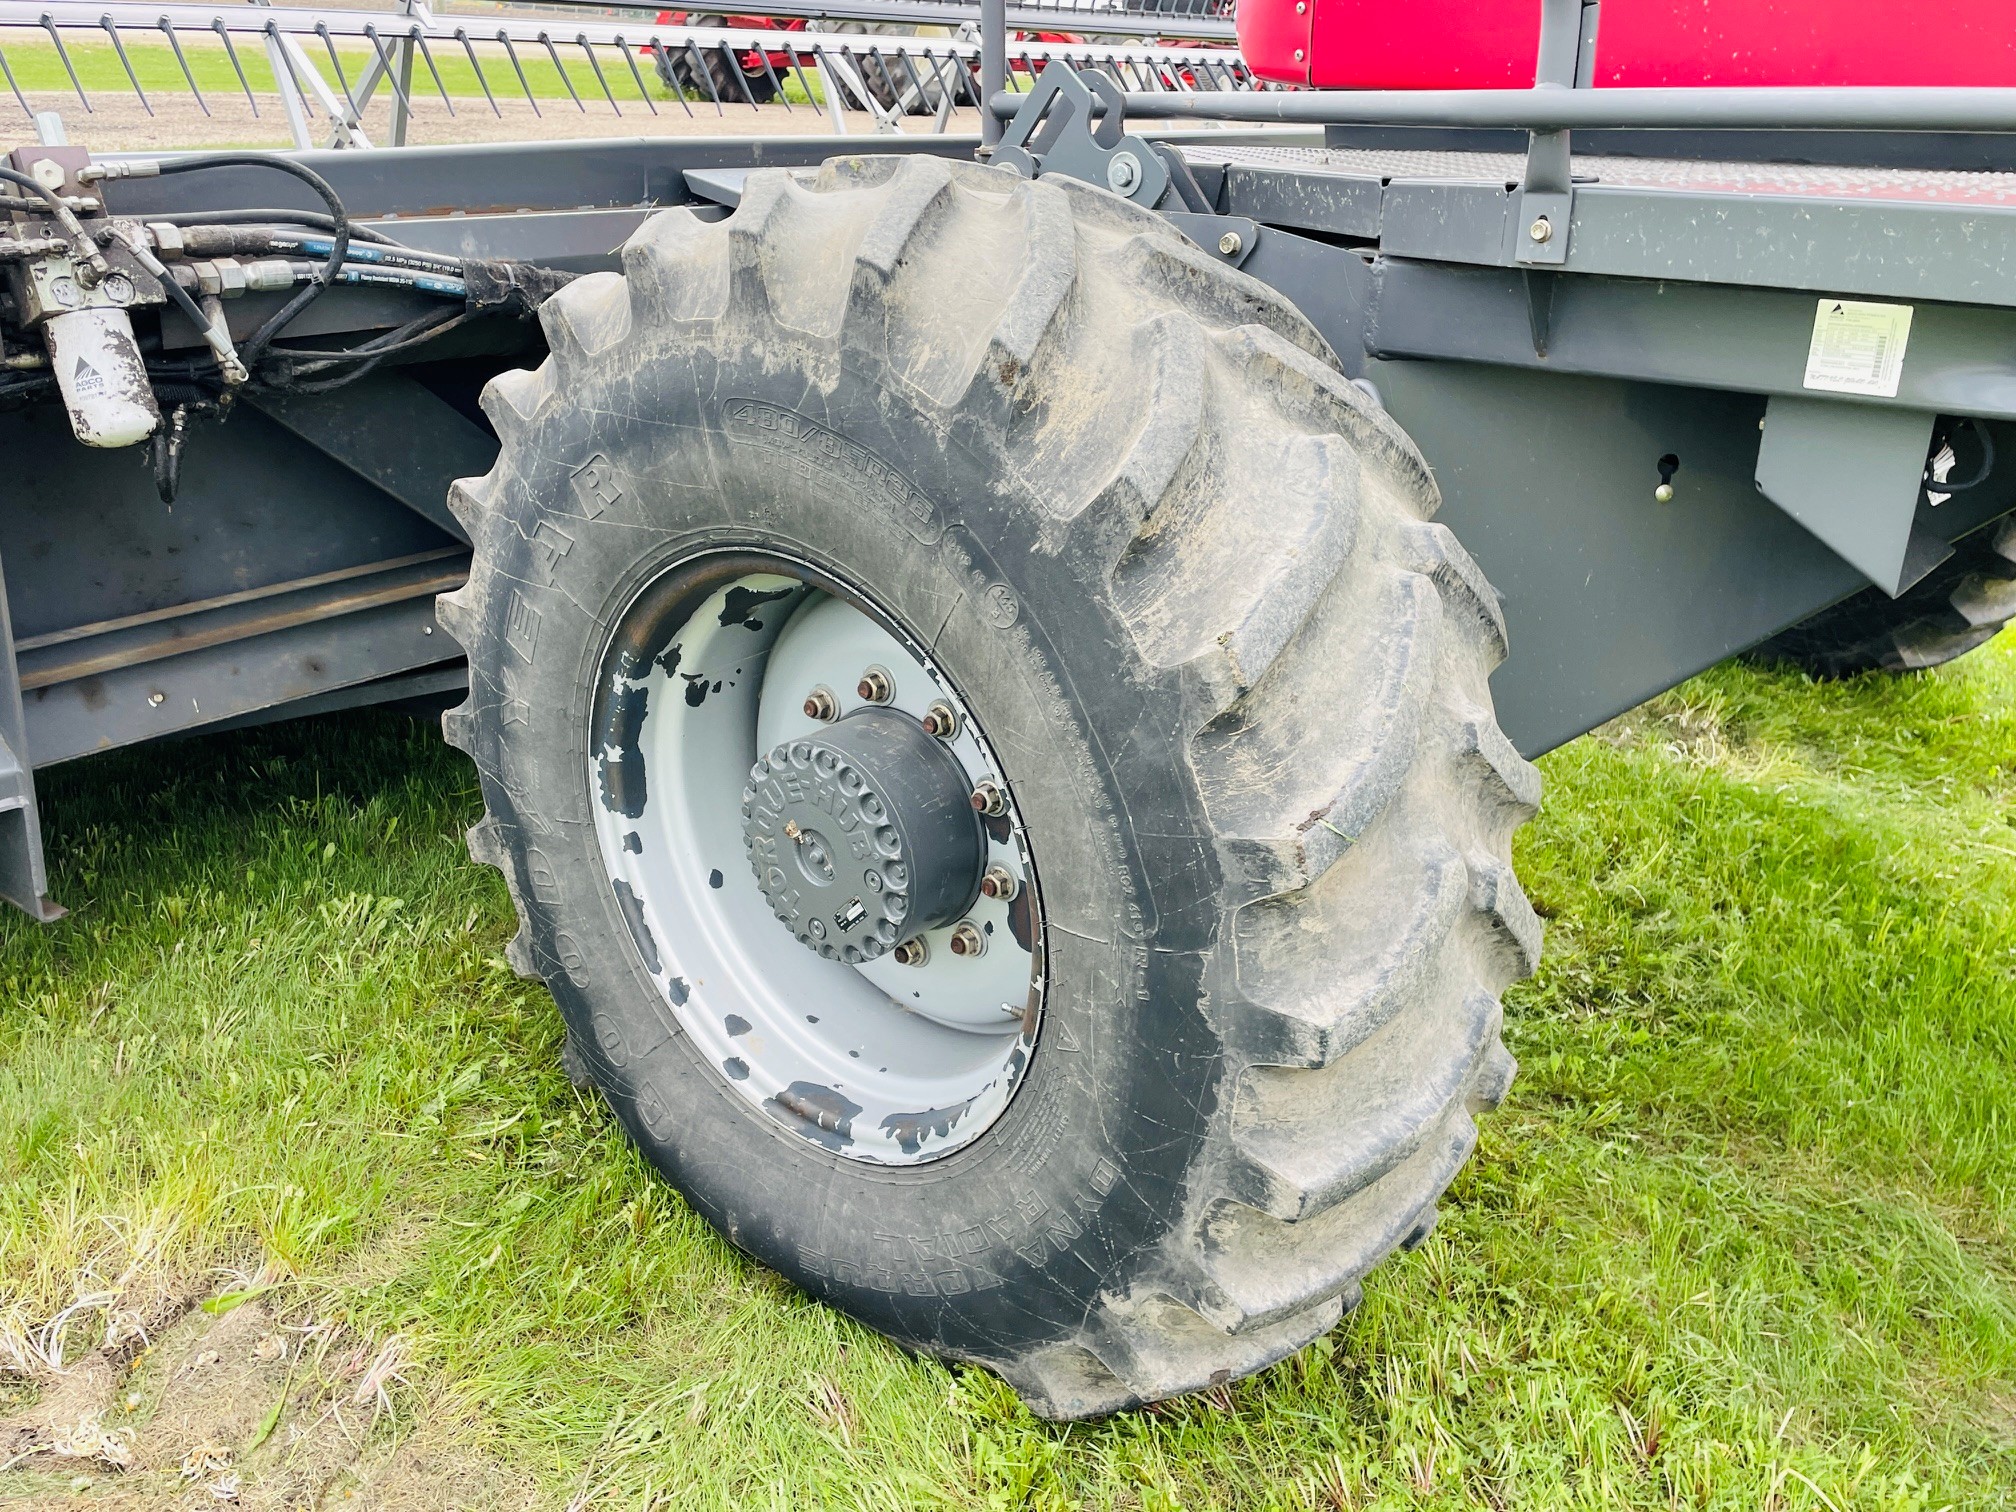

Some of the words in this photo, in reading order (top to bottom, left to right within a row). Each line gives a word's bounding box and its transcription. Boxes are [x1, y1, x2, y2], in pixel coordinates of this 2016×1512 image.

[76, 377, 103, 388] AGCO
[76, 382, 104, 392] PARTS
[873, 1189, 1050, 1262] RADIAL
[1016, 1156, 1123, 1268] DYNA
[797, 1243, 1004, 1297] TORQUE
